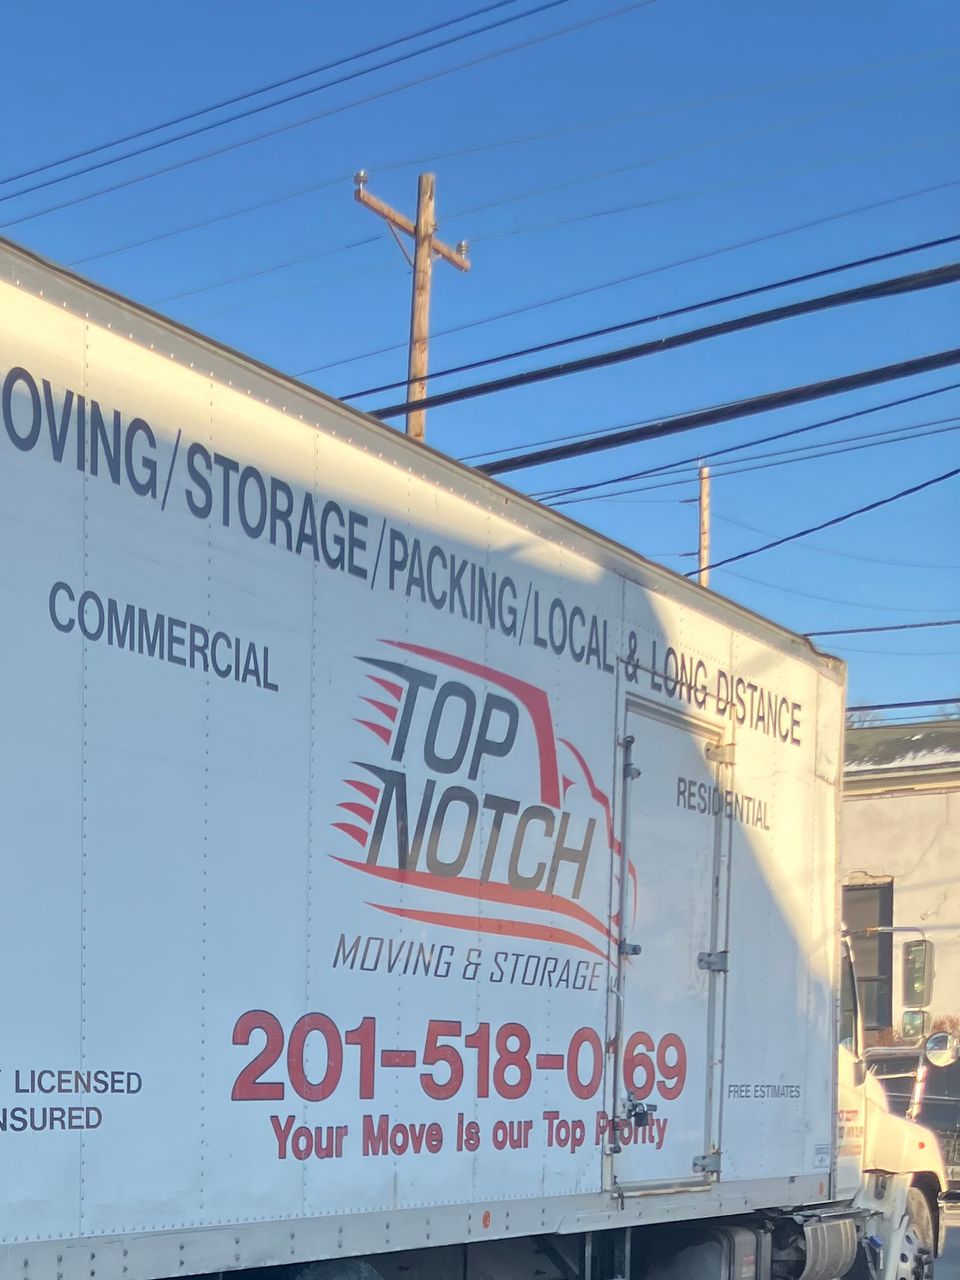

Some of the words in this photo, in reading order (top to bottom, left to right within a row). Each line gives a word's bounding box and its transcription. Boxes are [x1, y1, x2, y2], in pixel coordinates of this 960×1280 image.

[48, 581, 279, 692] COMMERCIAL
[353, 656, 519, 781] TOP
[624, 630, 640, 684] &
[651, 640, 708, 710] LONG
[715, 669, 801, 746] DISTANCE
[349, 760, 597, 899] NOTCH
[676, 776, 770, 831] RESIDENTIAL
[332, 933, 455, 979] MOVING
[462, 948, 482, 981] &
[489, 951, 604, 992] STORAGE
[15, 1070, 142, 1095] LICENSED
[231, 1009, 687, 1102] 201-518-069
[727, 1084, 751, 1099] FREE
[754, 1085, 801, 1099] ESTIMATES
[270, 1114, 348, 1160] Your
[362, 1114, 441, 1156] Move
[492, 1119, 534, 1151] our
[543, 1110, 586, 1153] Top
[594, 1111, 668, 1150] Prority
